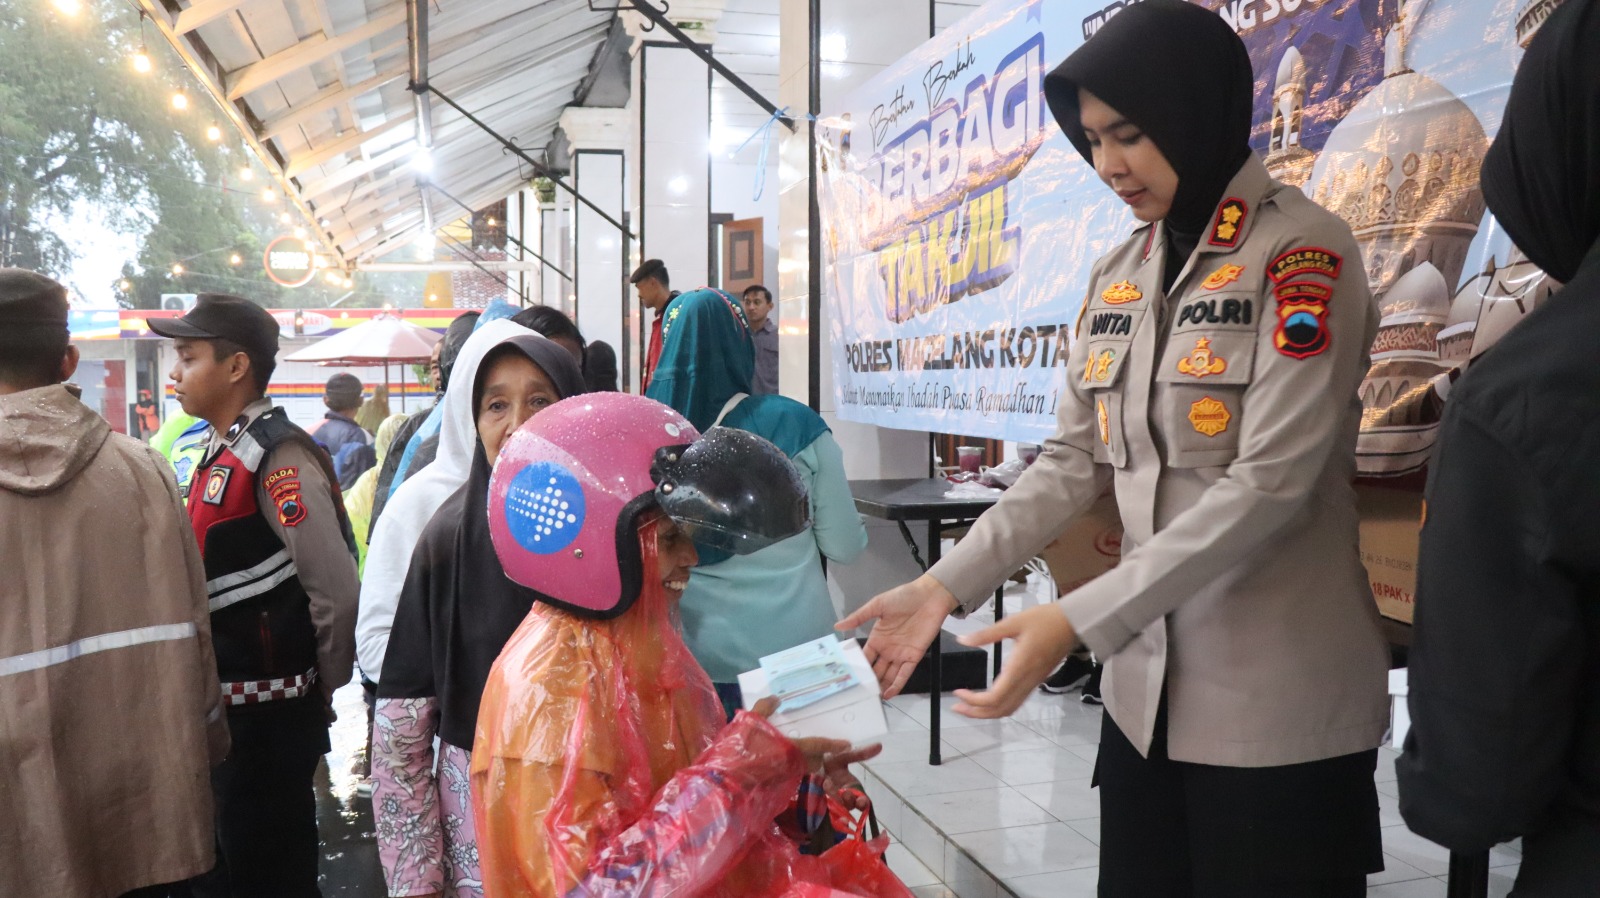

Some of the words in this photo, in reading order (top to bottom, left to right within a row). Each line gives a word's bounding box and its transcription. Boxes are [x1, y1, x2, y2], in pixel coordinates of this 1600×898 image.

[879, 180, 1020, 318] TAKJIL
[1277, 251, 1330, 269] POLRES
[1177, 298, 1253, 328] POLRI
[846, 339, 892, 373] POLRES
[897, 329, 994, 372] MAGELANG
[1000, 324, 1071, 368] KOTA
[906, 382, 939, 409] Ibadah
[942, 385, 972, 411] Puasa
[976, 381, 1045, 417] Ramadhan
[265, 468, 294, 487] POLDA
[1372, 581, 1382, 596] 18
[1384, 583, 1403, 602] PAK
